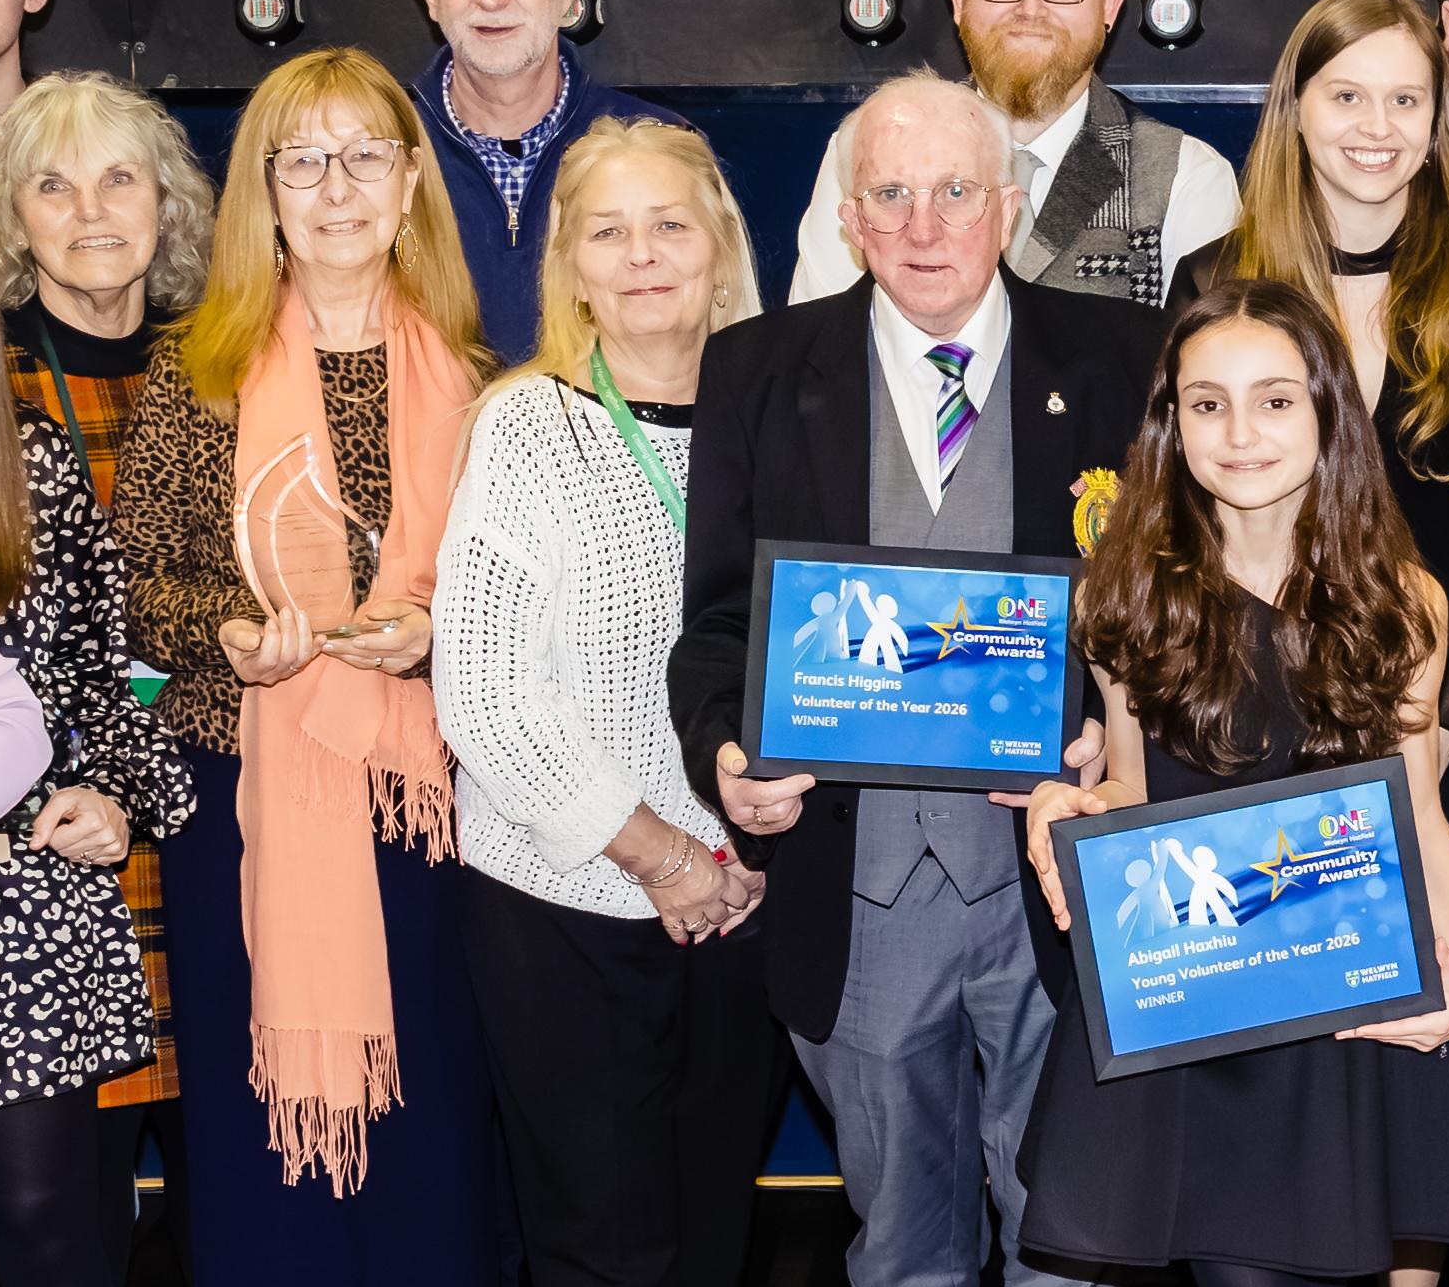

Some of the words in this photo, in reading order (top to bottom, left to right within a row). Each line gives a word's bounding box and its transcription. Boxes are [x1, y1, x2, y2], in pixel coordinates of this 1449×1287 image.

[997, 596, 1047, 618] ONE
[952, 631, 1046, 649] Community
[985, 646, 1045, 659] Awards
[794, 672, 844, 687] Francis
[848, 674, 902, 692] Higgins
[793, 694, 855, 709] Volunteer
[859, 699, 874, 710] of
[876, 700, 898, 711] the
[902, 701, 930, 713] Year
[934, 702, 967, 715] 2026
[792, 715, 838, 727] WINNER
[1004, 748, 1041, 756] HATFIELD
[1005, 740, 1041, 749] WELWYN
[1319, 809, 1372, 838] ONE
[1280, 850, 1377, 878] Community
[1318, 863, 1381, 884] Awards
[1128, 944, 1180, 967] Abigail
[1184, 934, 1238, 955] Haxhiu
[1132, 972, 1176, 990] Young
[1178, 959, 1244, 980] Volunteer
[1248, 952, 1263, 966] of
[1265, 949, 1289, 963] the
[1291, 942, 1322, 958] Year
[1325, 933, 1360, 951] 2026
[1360, 962, 1398, 975] WELWYN
[1361, 970, 1399, 984] HATFIELD
[1136, 990, 1185, 1010] WINNER
